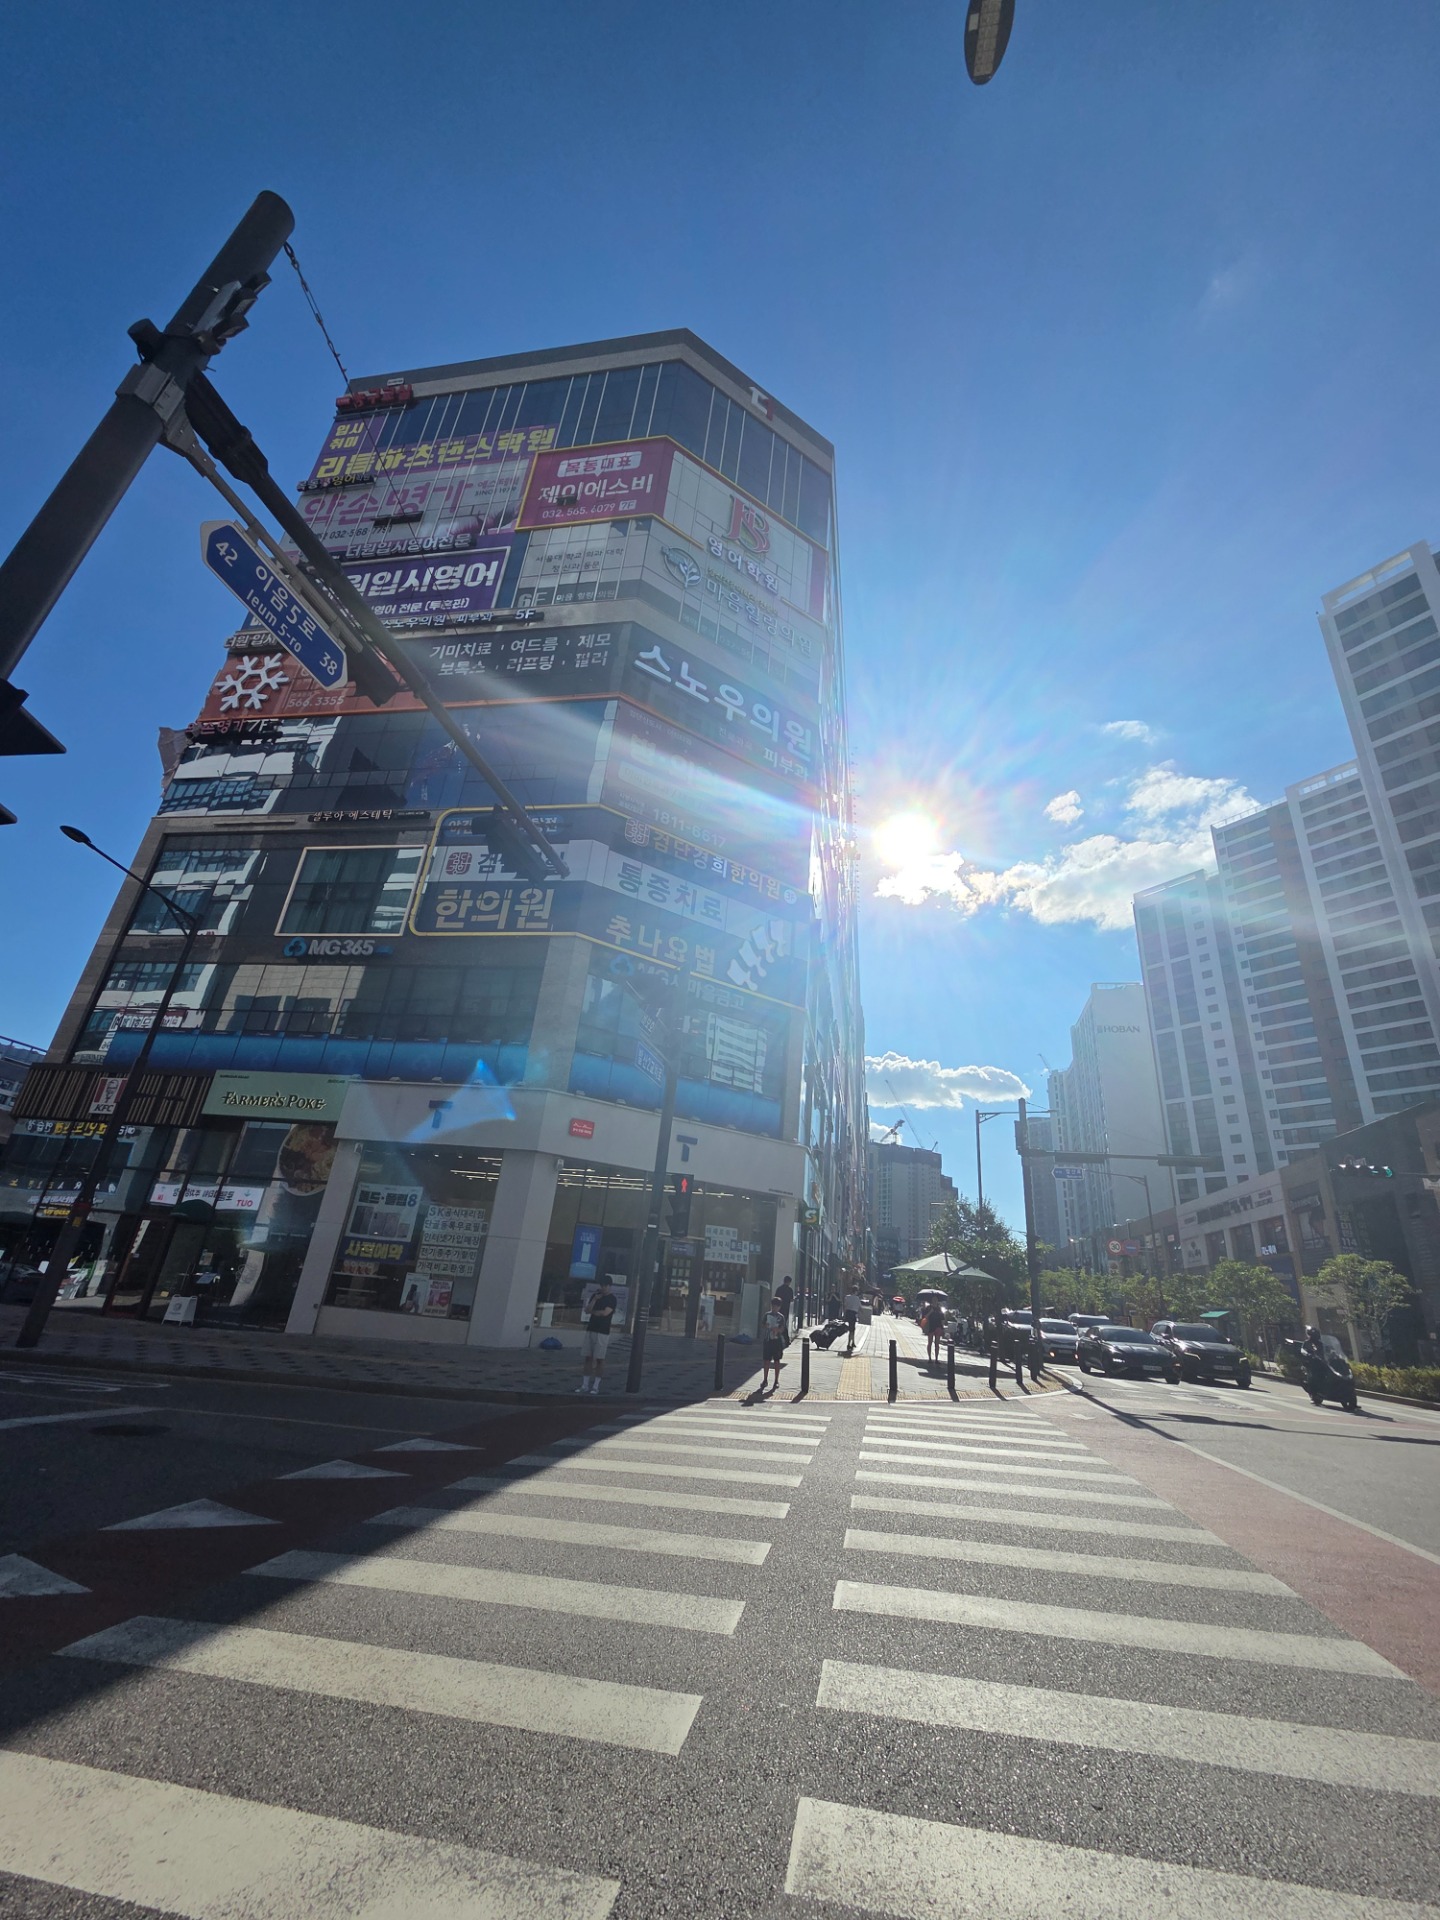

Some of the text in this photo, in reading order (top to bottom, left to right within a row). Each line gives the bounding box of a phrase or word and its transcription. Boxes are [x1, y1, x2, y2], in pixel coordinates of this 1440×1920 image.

[336, 422, 364, 436] 입시
[329, 436, 359, 449] 취미
[538, 474, 653, 504] 제이에스비
[215, 542, 239, 567] 42
[255, 565, 317, 641] 이음5로
[514, 609, 536, 619] 5F
[246, 589, 302, 652] Ieum 5-ro
[429, 632, 612, 659] 기미치료 여드름 제모
[319, 652, 338, 676] 38
[437, 660, 486, 676] 보톡스
[506, 655, 555, 672] 리프팅
[634, 645, 811, 761] 스노우의원
[763, 747, 808, 783] 피부과
[617, 860, 723, 922] 통증치료
[435, 887, 555, 930] 한의원
[308, 939, 375, 956] MG365
[606, 914, 716, 976] 추나요법
[1103, 1025, 1140, 1034] HOBAN
[93, 1103, 115, 1113] KFC
